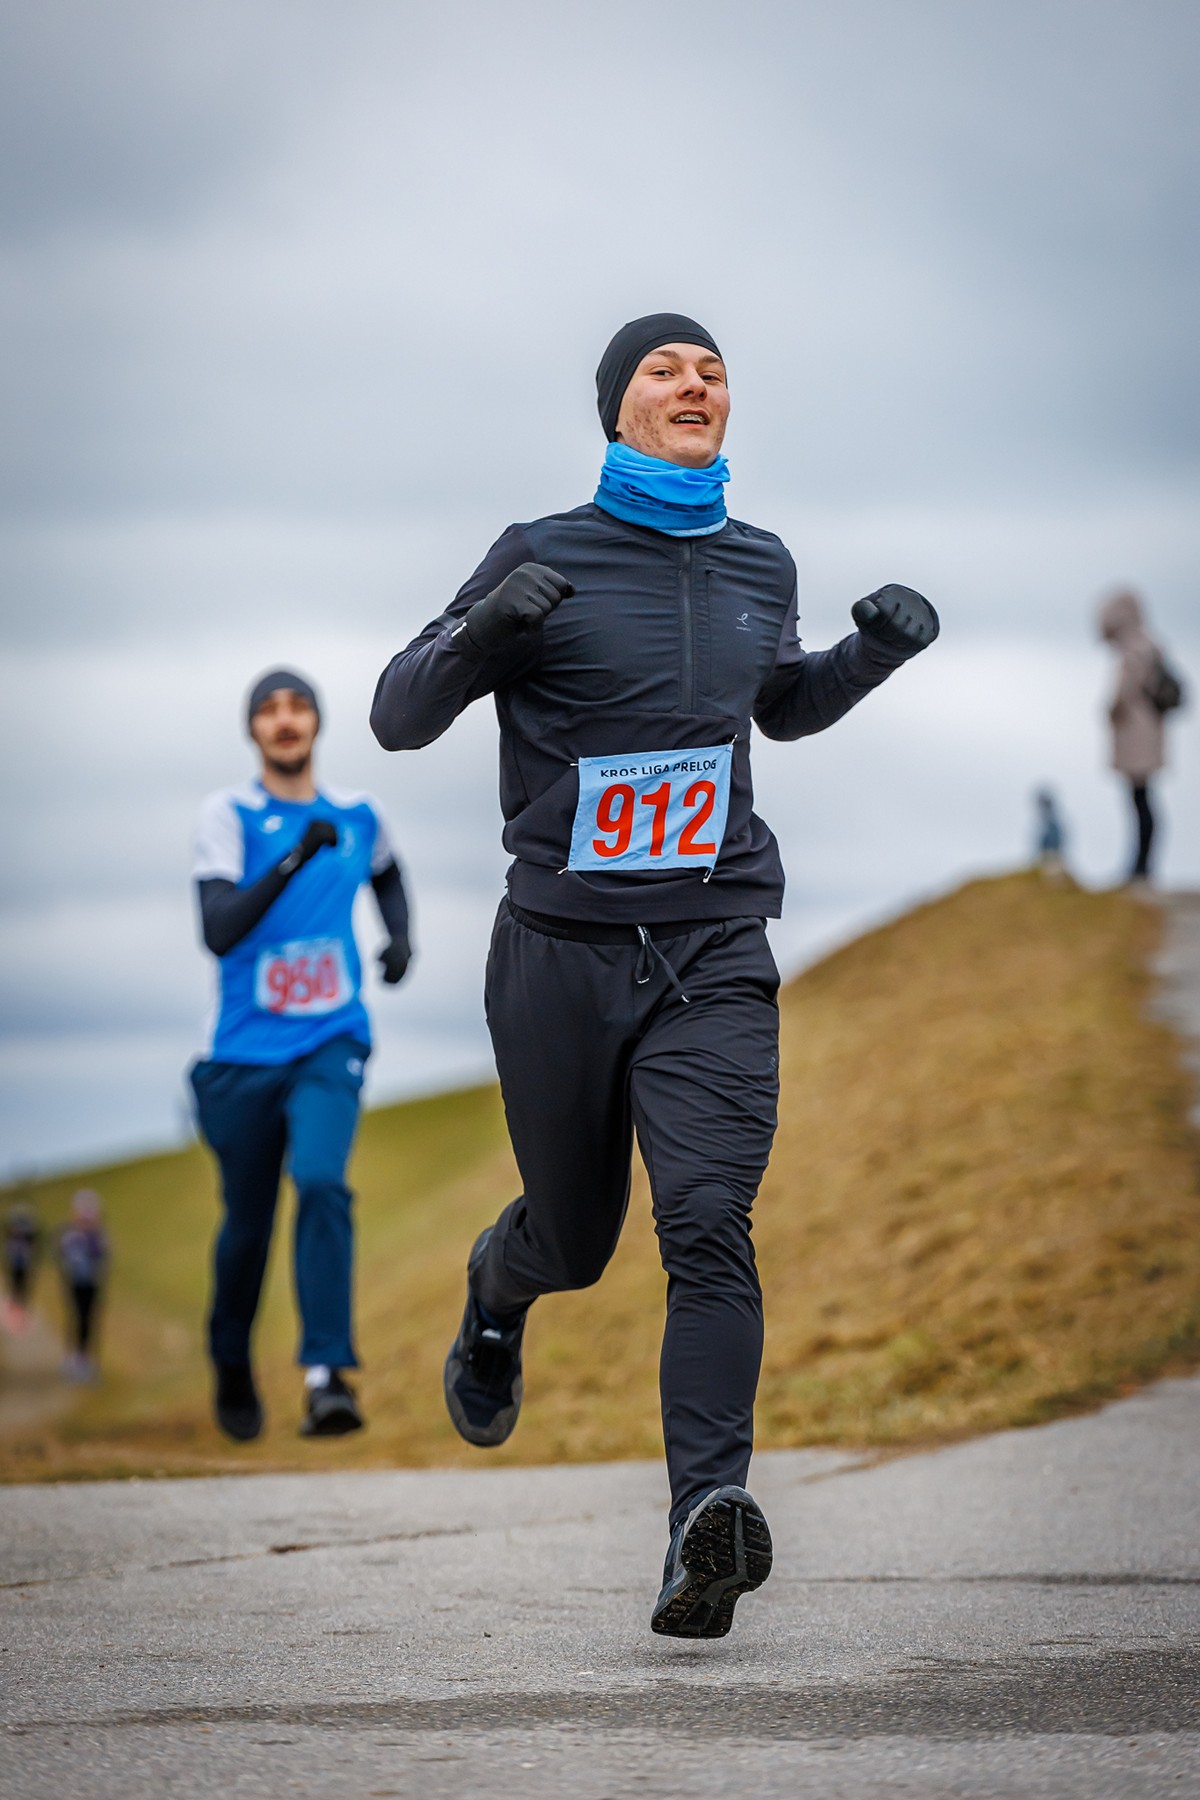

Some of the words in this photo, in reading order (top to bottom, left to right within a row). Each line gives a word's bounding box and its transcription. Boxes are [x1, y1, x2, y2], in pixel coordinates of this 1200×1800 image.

[600, 767, 638, 778] KROS
[641, 764, 670, 775] LIGA
[672, 759, 717, 772] PRELOG
[592, 780, 716, 858] 912
